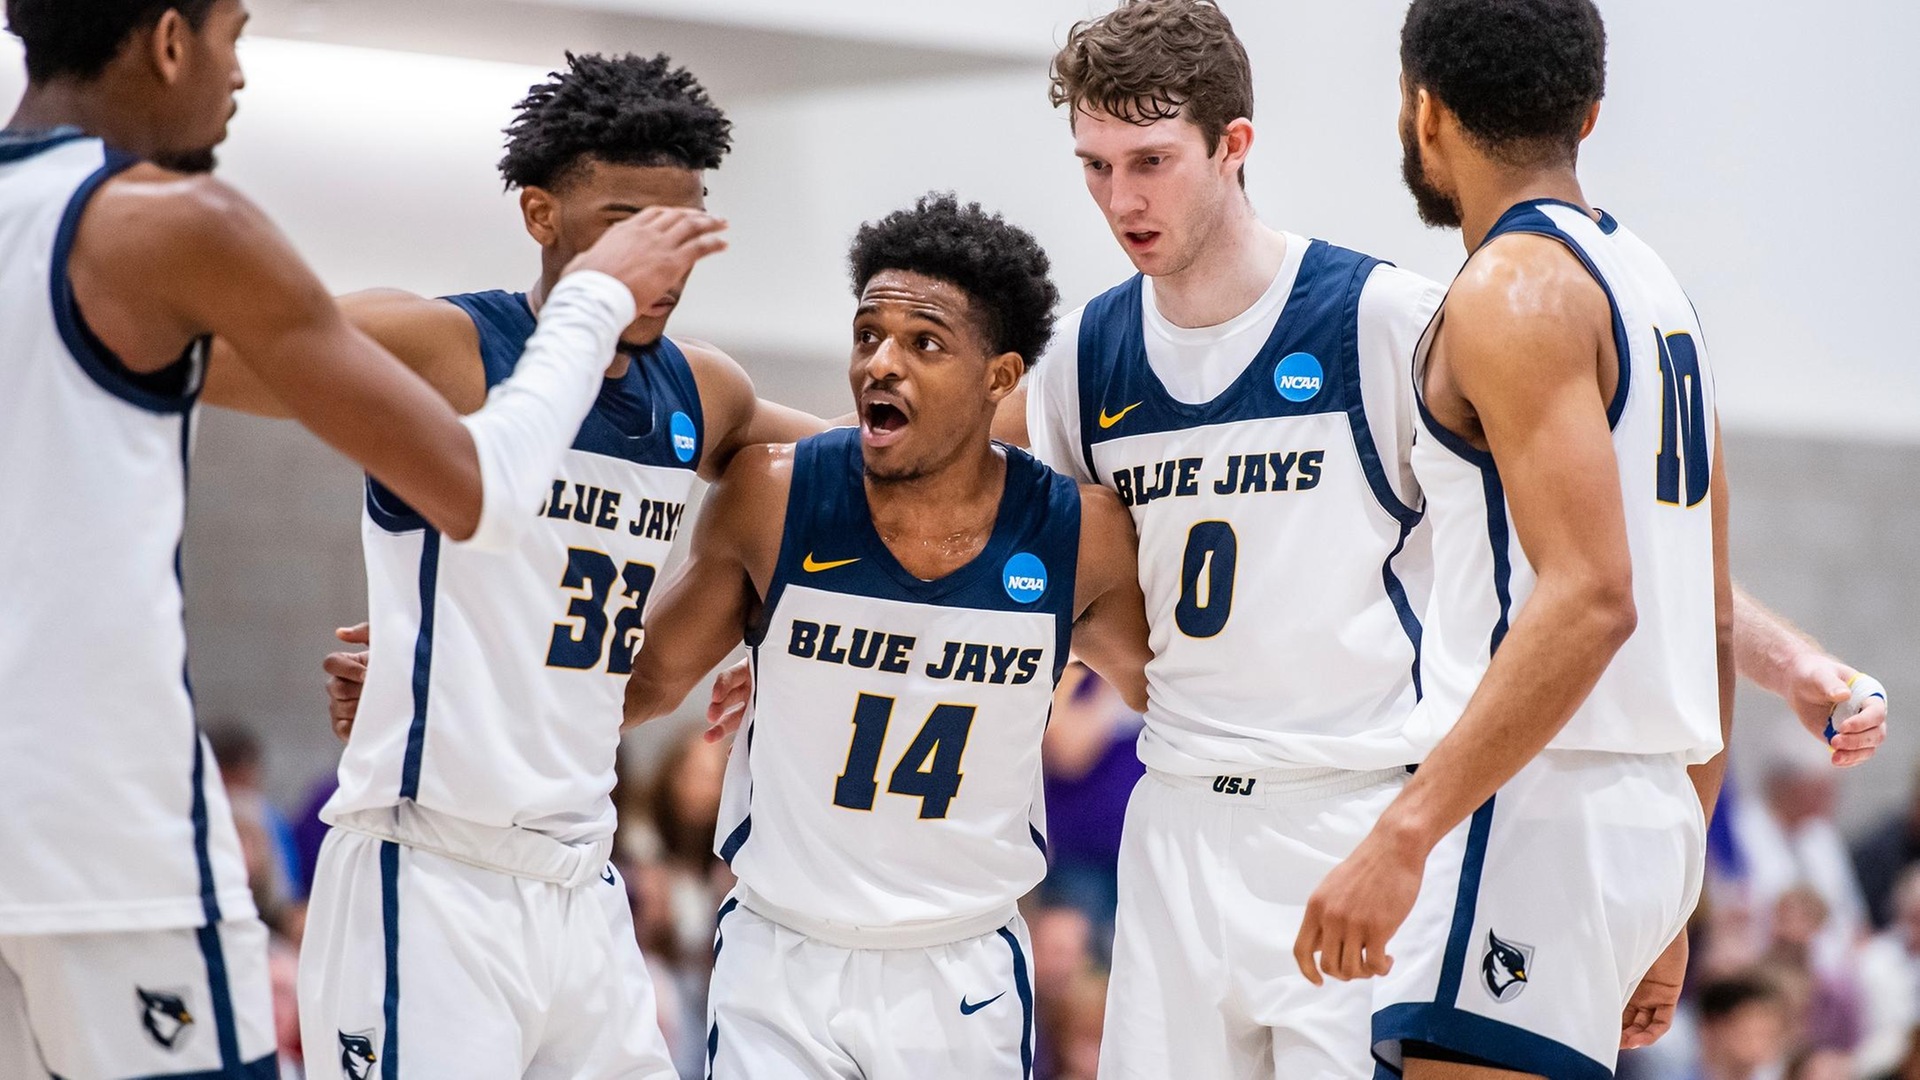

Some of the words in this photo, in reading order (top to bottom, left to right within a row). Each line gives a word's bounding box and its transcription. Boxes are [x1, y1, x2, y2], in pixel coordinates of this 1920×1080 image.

[1279, 374, 1320, 390] NCAA
[1652, 324, 1710, 509] 10
[537, 479, 621, 531] LUE
[1111, 456, 1204, 507] BLUE
[1213, 449, 1325, 495] JAYS
[1007, 575, 1045, 592] NCAA
[1174, 517, 1238, 639] 0
[545, 546, 657, 676] 32
[787, 619, 917, 675] BLUE
[925, 641, 1044, 686] JAYS
[832, 691, 979, 821] 14
[1212, 775, 1257, 796] USJ
